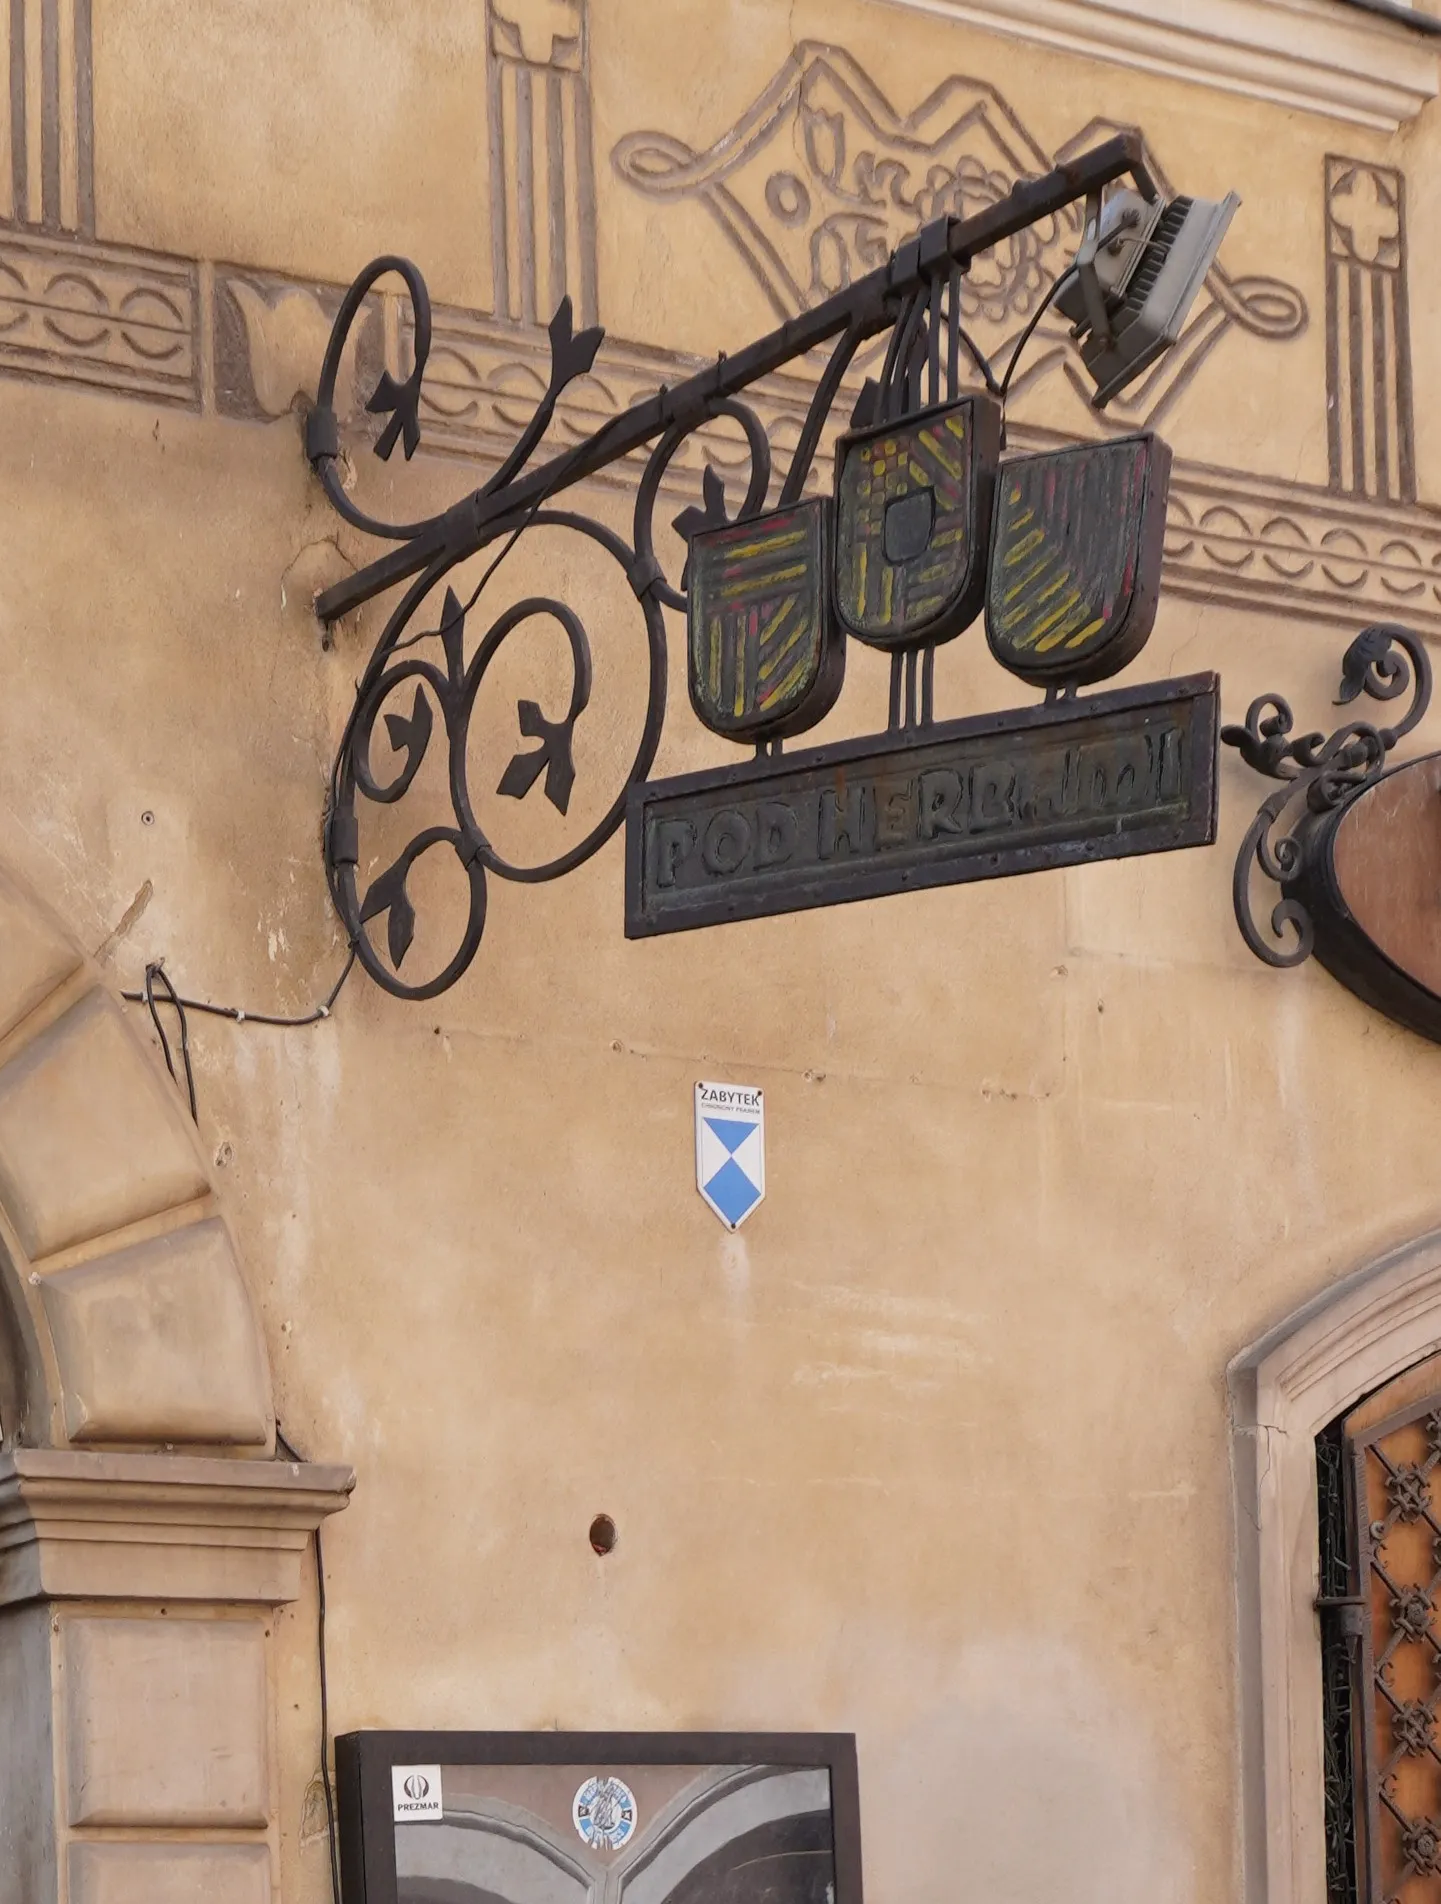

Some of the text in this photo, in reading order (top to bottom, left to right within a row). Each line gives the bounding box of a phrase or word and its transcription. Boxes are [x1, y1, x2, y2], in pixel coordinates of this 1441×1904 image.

[656, 799, 799, 888] POD
[701, 1088, 760, 1106] ZABYTEK
[397, 1802, 440, 1812] PREZMAR
